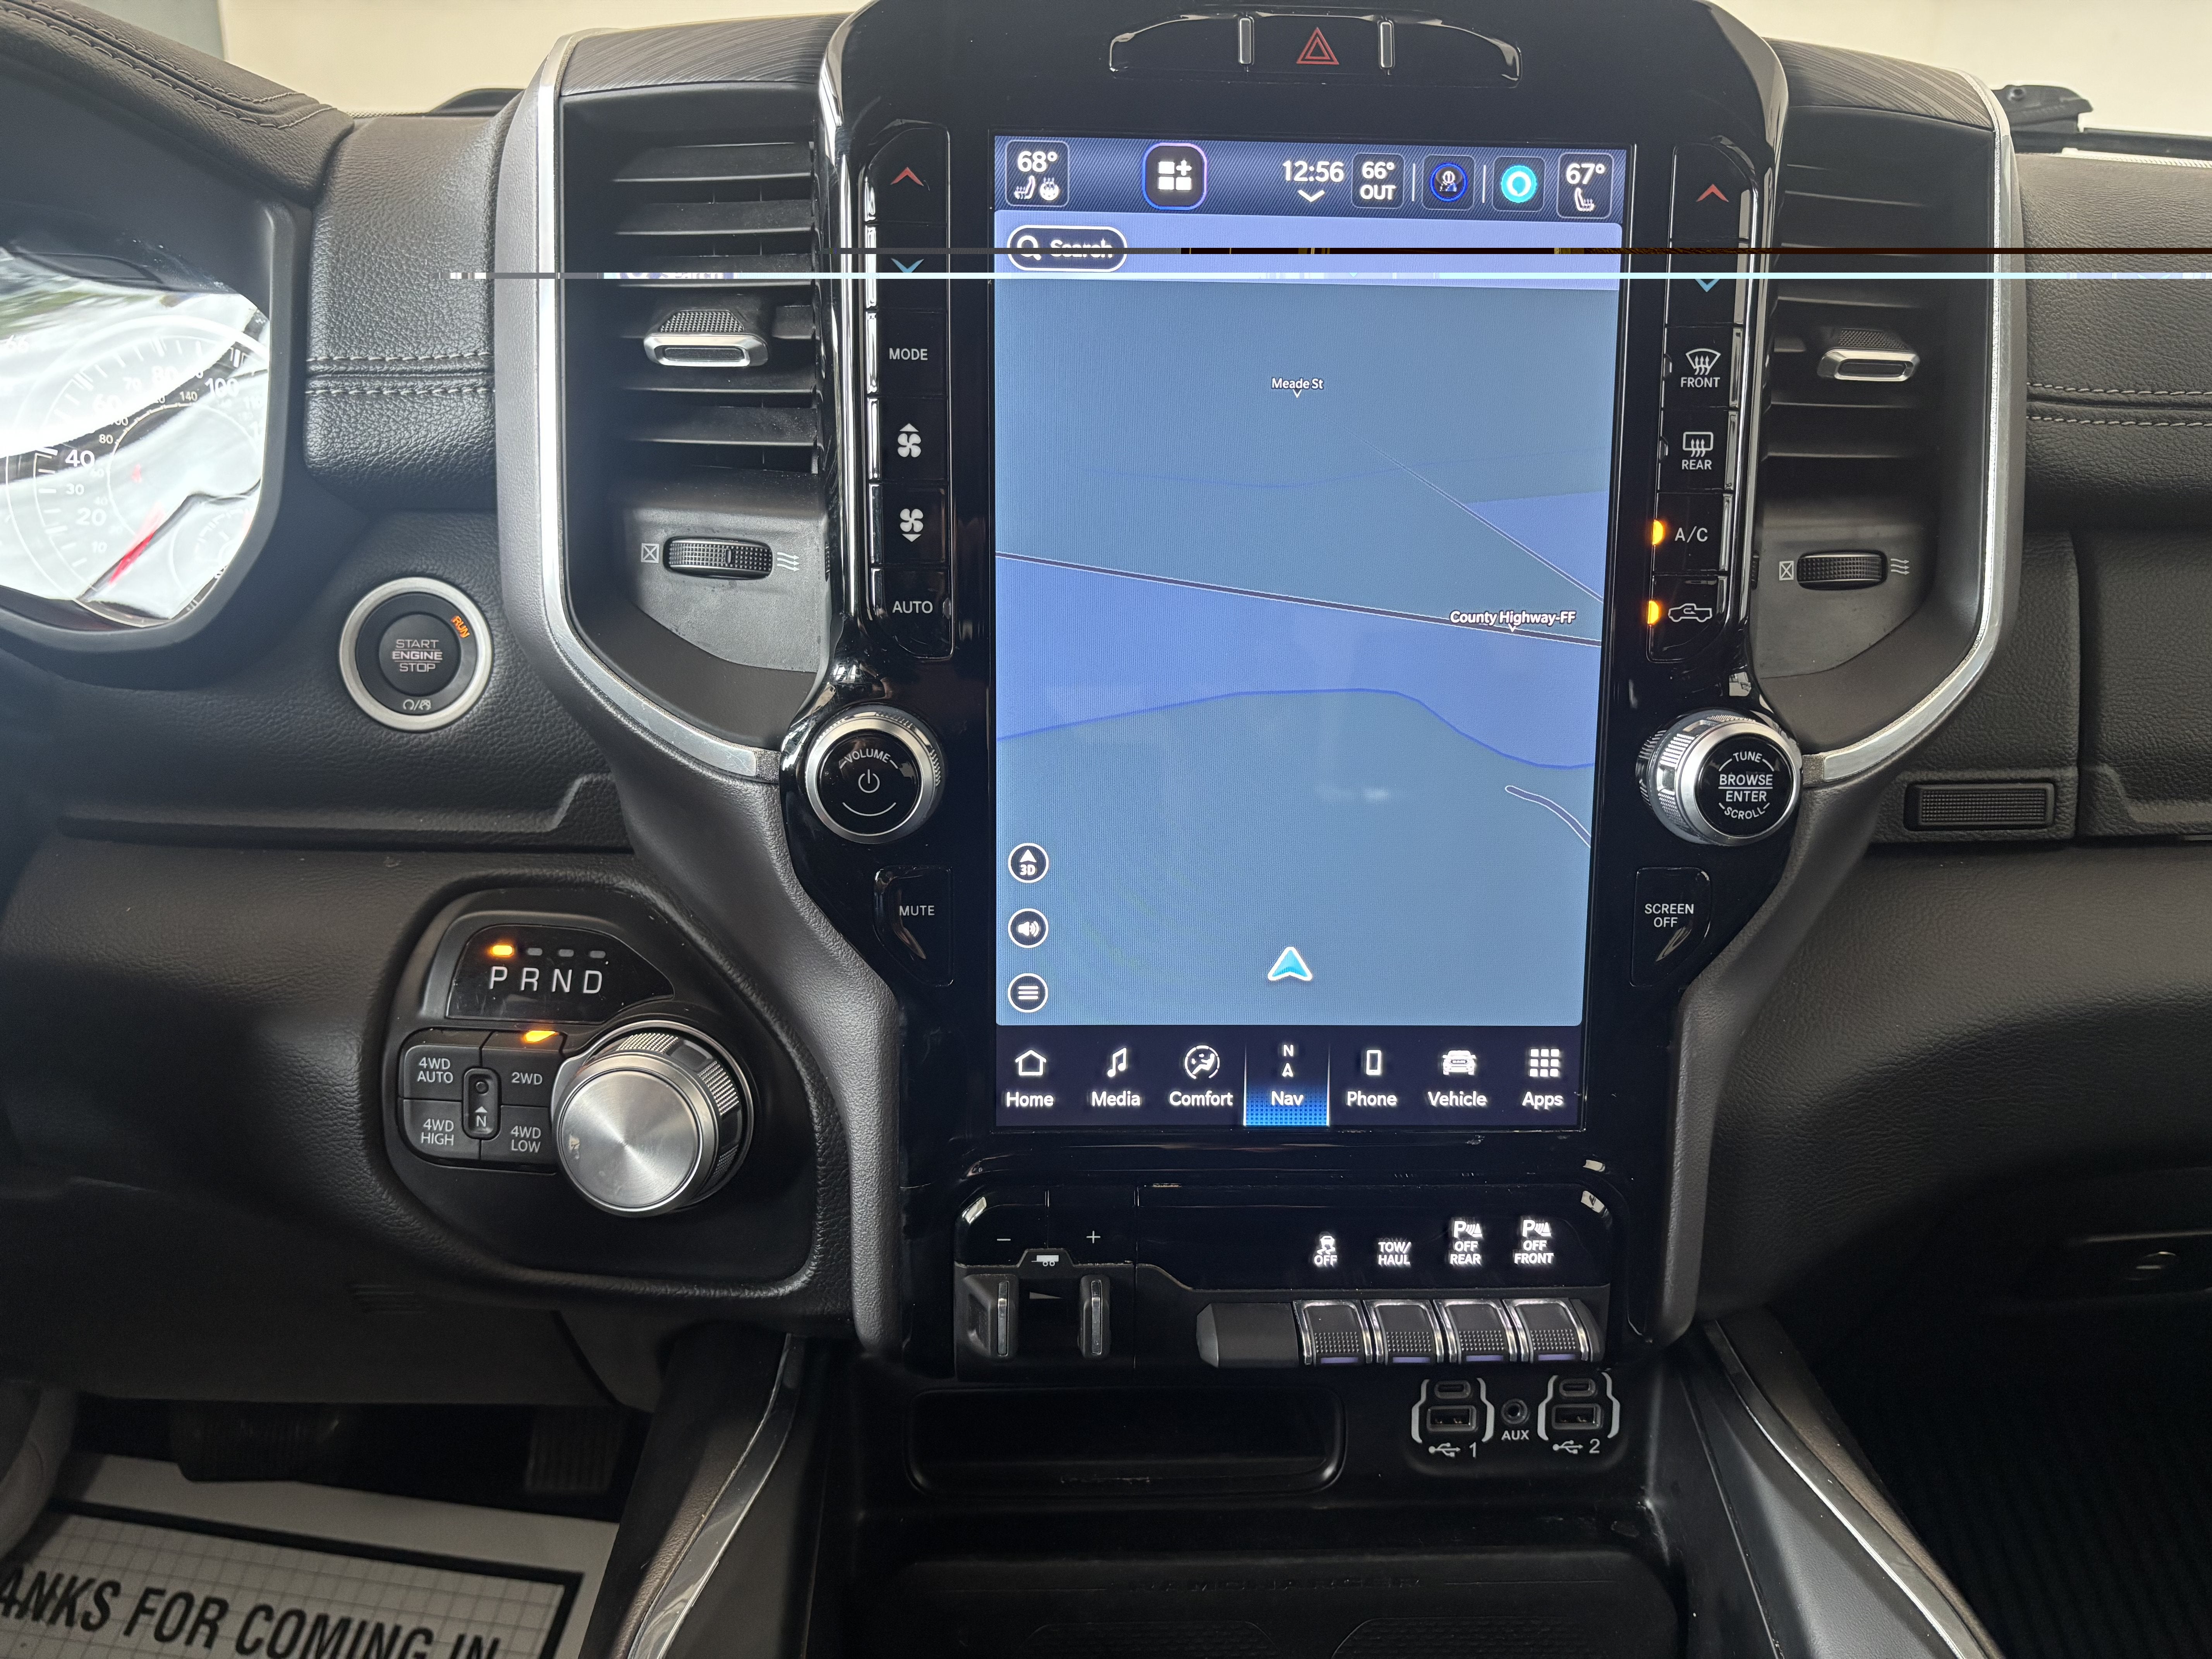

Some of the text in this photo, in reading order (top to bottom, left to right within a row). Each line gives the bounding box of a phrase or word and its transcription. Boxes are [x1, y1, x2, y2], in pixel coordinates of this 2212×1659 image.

[1017, 150, 1058, 172] 68°
[1283, 160, 1345, 182] 12:56
[1361, 161, 1395, 179] 66°
[1566, 163, 1606, 185] 67°
[1360, 184, 1396, 201] OUT
[889, 348, 928, 361] MODE
[204, 378, 240, 398] 100
[1272, 378, 1323, 389] Meade St
[1680, 377, 1720, 388] FRONT
[179, 391, 198, 403] 140
[99, 434, 113, 445] 80
[65, 449, 95, 468] 40
[1681, 460, 1712, 470] REAR
[65, 483, 85, 496] 30
[76, 507, 106, 526] 20
[1674, 526, 1708, 542] A/C
[92, 541, 108, 554] 10
[892, 601, 933, 613] AUTO
[1450, 610, 1576, 626] County Highway-FF
[451, 615, 470, 638] RUN
[395, 639, 439, 648] START
[392, 651, 443, 660] ENGINE
[399, 663, 436, 672] STOP
[844, 748, 891, 763] VOLUME
[1733, 751, 1763, 763] TUNE
[1719, 775, 1773, 786] BROWSE
[1726, 791, 1767, 802] ENTER
[1724, 807, 1766, 819] SCROLL
[1020, 864, 1036, 876] 3D
[899, 905, 935, 916] MUTE
[1644, 904, 1694, 914] SCREEN
[1653, 917, 1678, 928] OFF
[489, 966, 602, 994] P R N D
[1283, 1044, 1294, 1056] N
[419, 1057, 451, 1070] 4WD
[417, 1071, 453, 1084] AUTO
[511, 1072, 543, 1085] 2WD
[1006, 1092, 1054, 1108] Home
[1091, 1091, 1141, 1107] Media
[1169, 1091, 1233, 1107] Comfort
[1271, 1091, 1304, 1106] Nav
[1346, 1091, 1397, 1107] Phone
[1427, 1091, 1487, 1107] Vehicle
[1522, 1091, 1563, 1110] Apps
[423, 1119, 454, 1132] 4WD
[476, 1115, 486, 1127] N
[421, 1132, 454, 1146] HIGH
[511, 1126, 541, 1139] 4WD
[511, 1139, 541, 1153] LOW
[1378, 1242, 1412, 1254] TOW/
[1454, 1241, 1479, 1252] OFF
[1523, 1240, 1547, 1251] OFF
[1314, 1255, 1338, 1267] OFF
[1378, 1254, 1411, 1267] HAUL
[1450, 1253, 1481, 1265] REAR
[1514, 1252, 1554, 1264] FRONT
[1501, 1430, 1529, 1440] AUX
[1469, 1442, 1478, 1458] 1
[1589, 1438, 1601, 1454] 2
[123, 1586, 230, 1649] FOR
[235, 1603, 434, 1659] COMING
